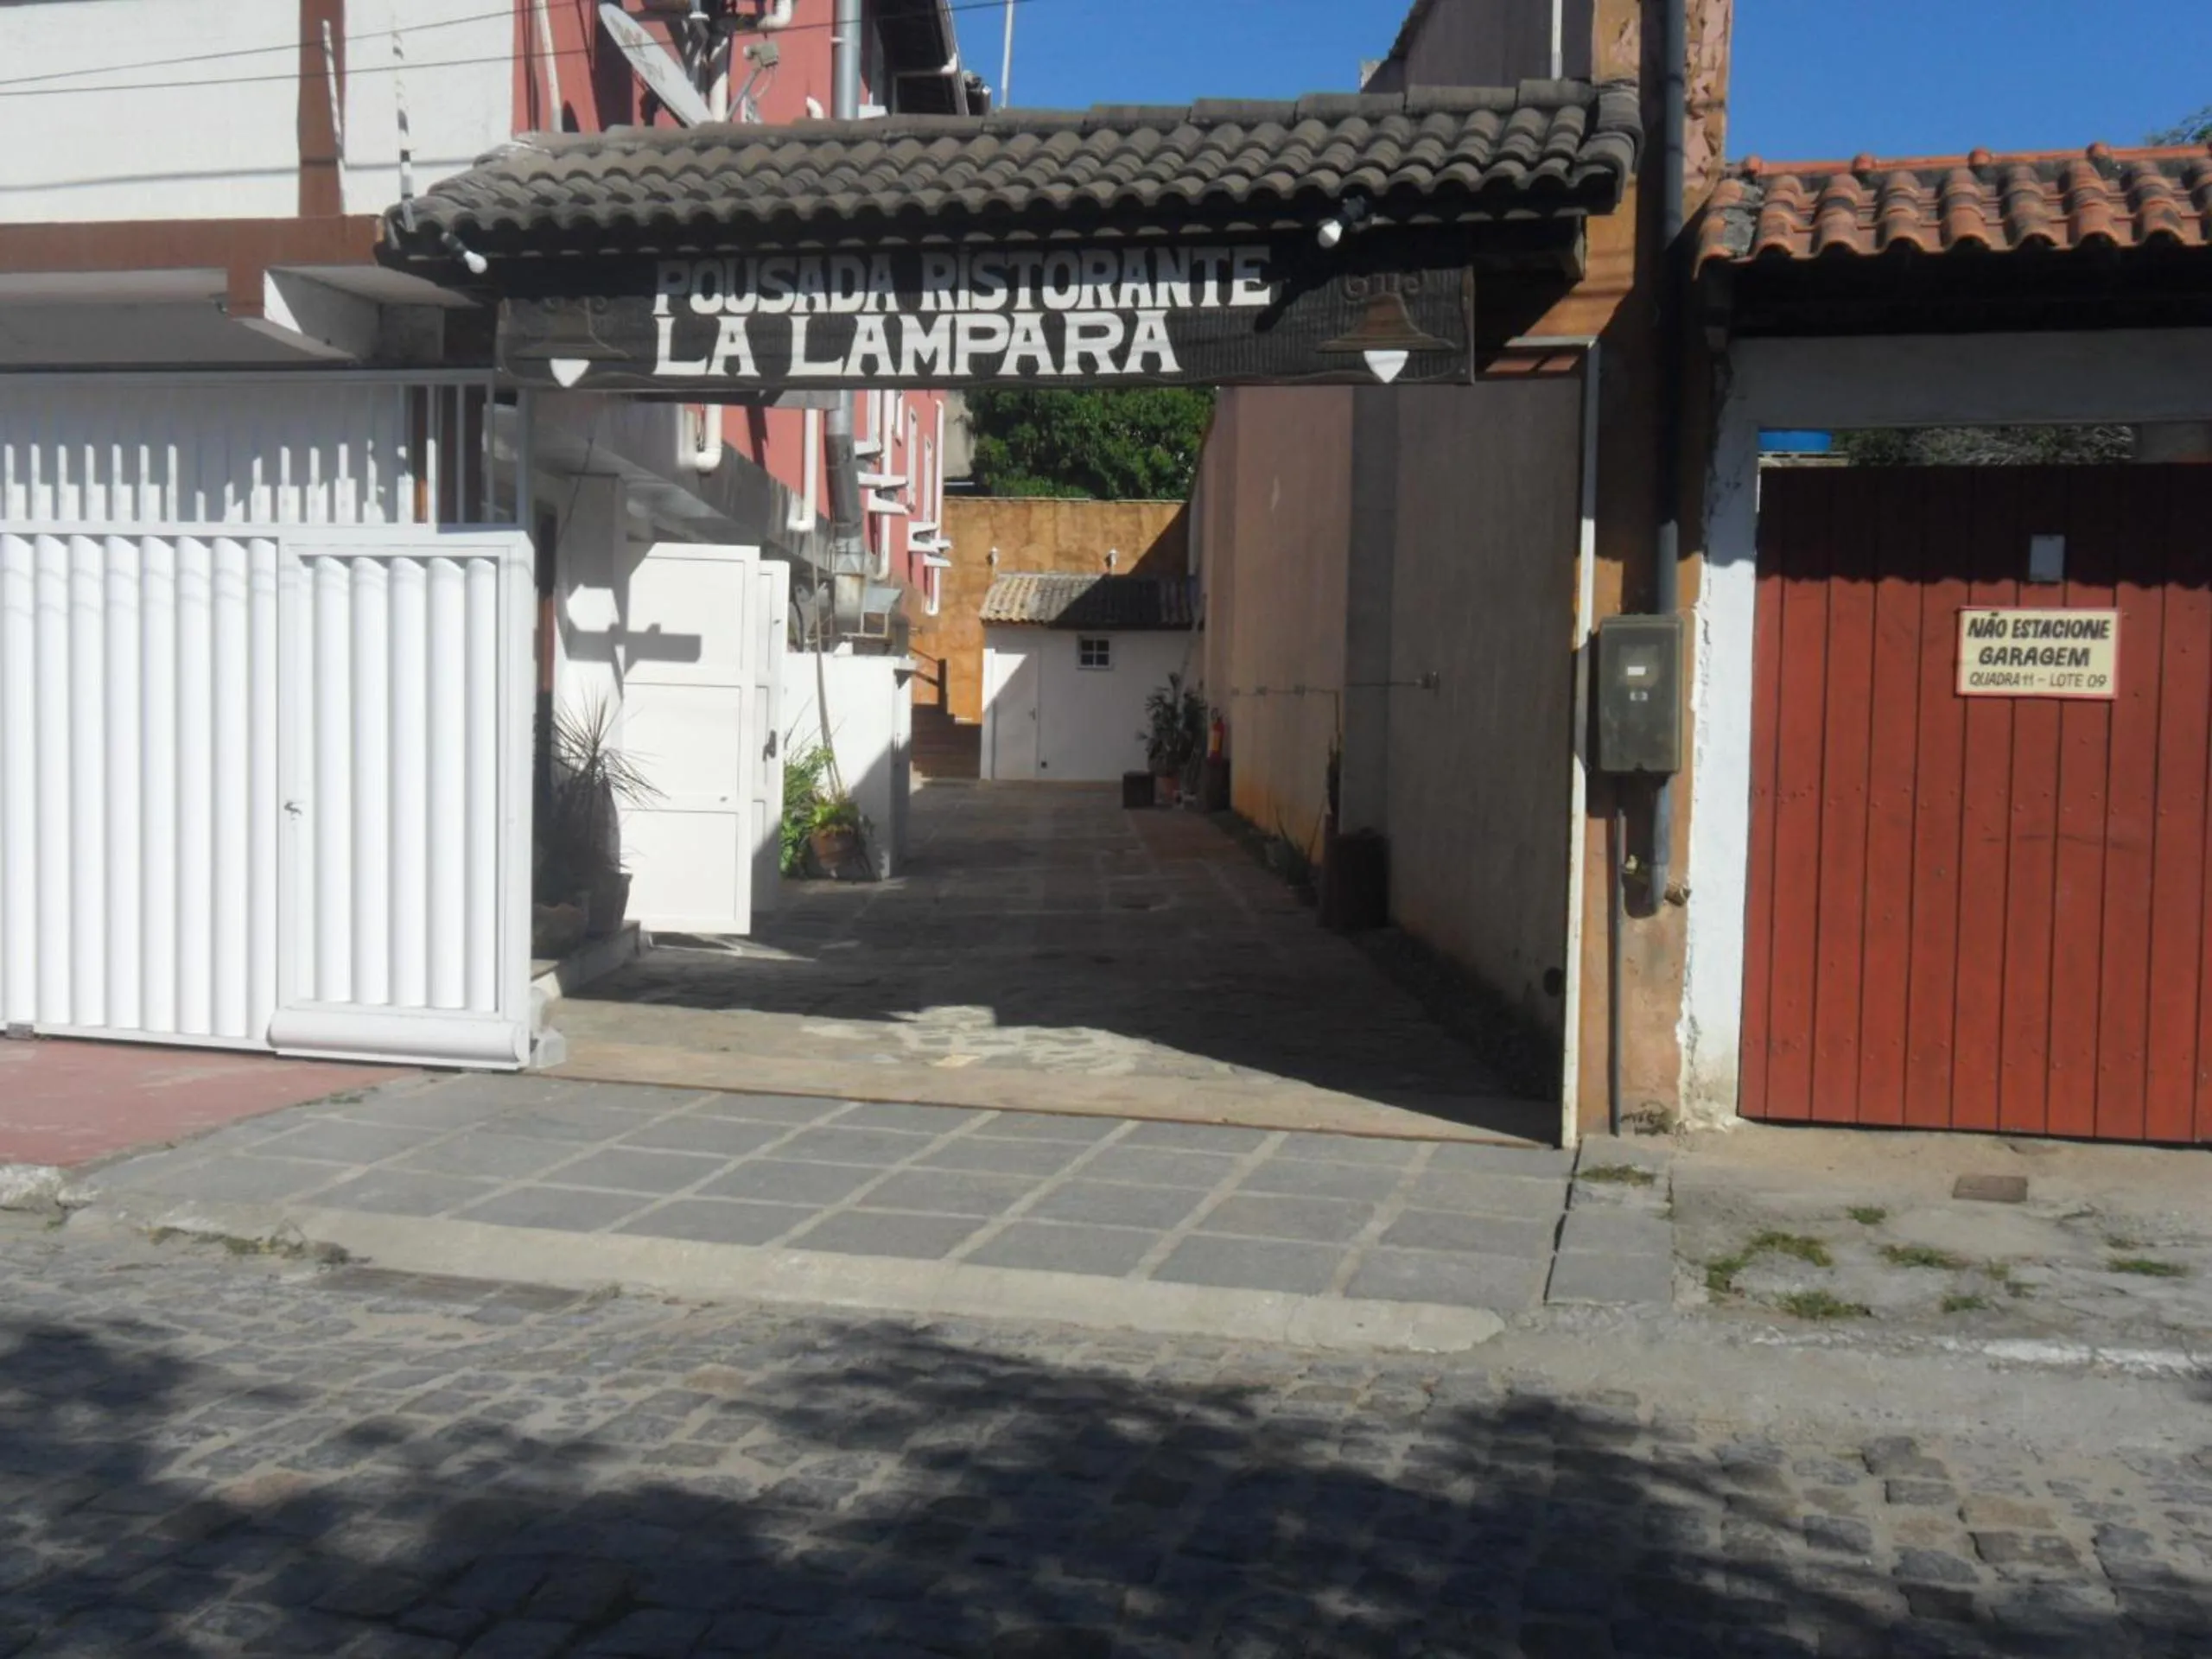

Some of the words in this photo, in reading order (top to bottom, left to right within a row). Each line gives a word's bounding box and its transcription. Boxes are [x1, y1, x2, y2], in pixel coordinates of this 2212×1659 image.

[652, 256, 899, 314] POUSADA
[919, 245, 1270, 310] RISTORANTE
[652, 316, 760, 376] LA
[786, 310, 1183, 377] LAMPARA
[1967, 612, 2007, 638] NÃO
[2012, 618, 2111, 639] ESTACIONE
[1978, 646, 2090, 666] GARAGEM
[1969, 671, 2021, 686] QUADRA
[2050, 672, 2083, 687] LOTE
[2087, 674, 2107, 687] 09
